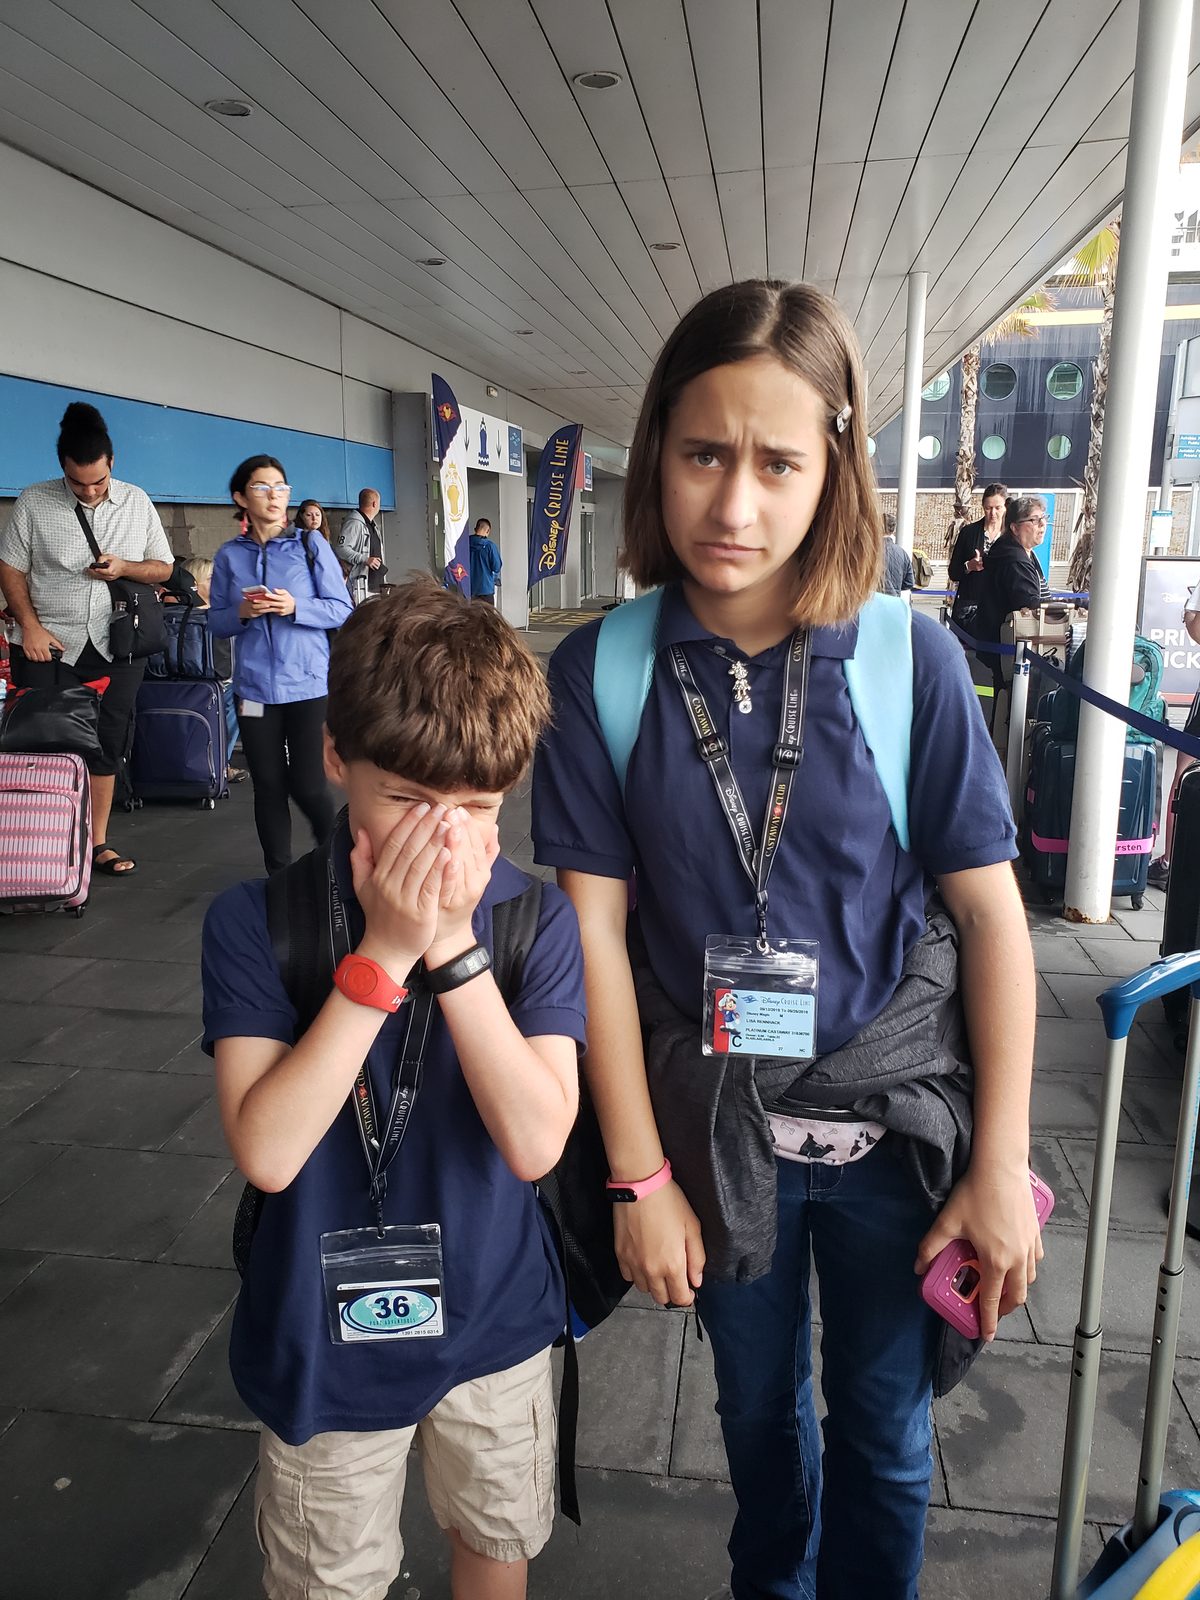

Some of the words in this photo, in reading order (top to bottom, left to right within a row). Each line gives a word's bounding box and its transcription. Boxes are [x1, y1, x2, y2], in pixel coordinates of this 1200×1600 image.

[550, 439, 569, 466] LINE
[1163, 650, 1200, 669] ICK
[787, 692, 798, 709] LINE
[785, 709, 797, 734] CRUISE
[765, 815, 781, 858] CASTAWAY
[775, 784, 786, 806] CLUB
[732, 1035, 742, 1048] C
[374, 1295, 410, 1319] 36
